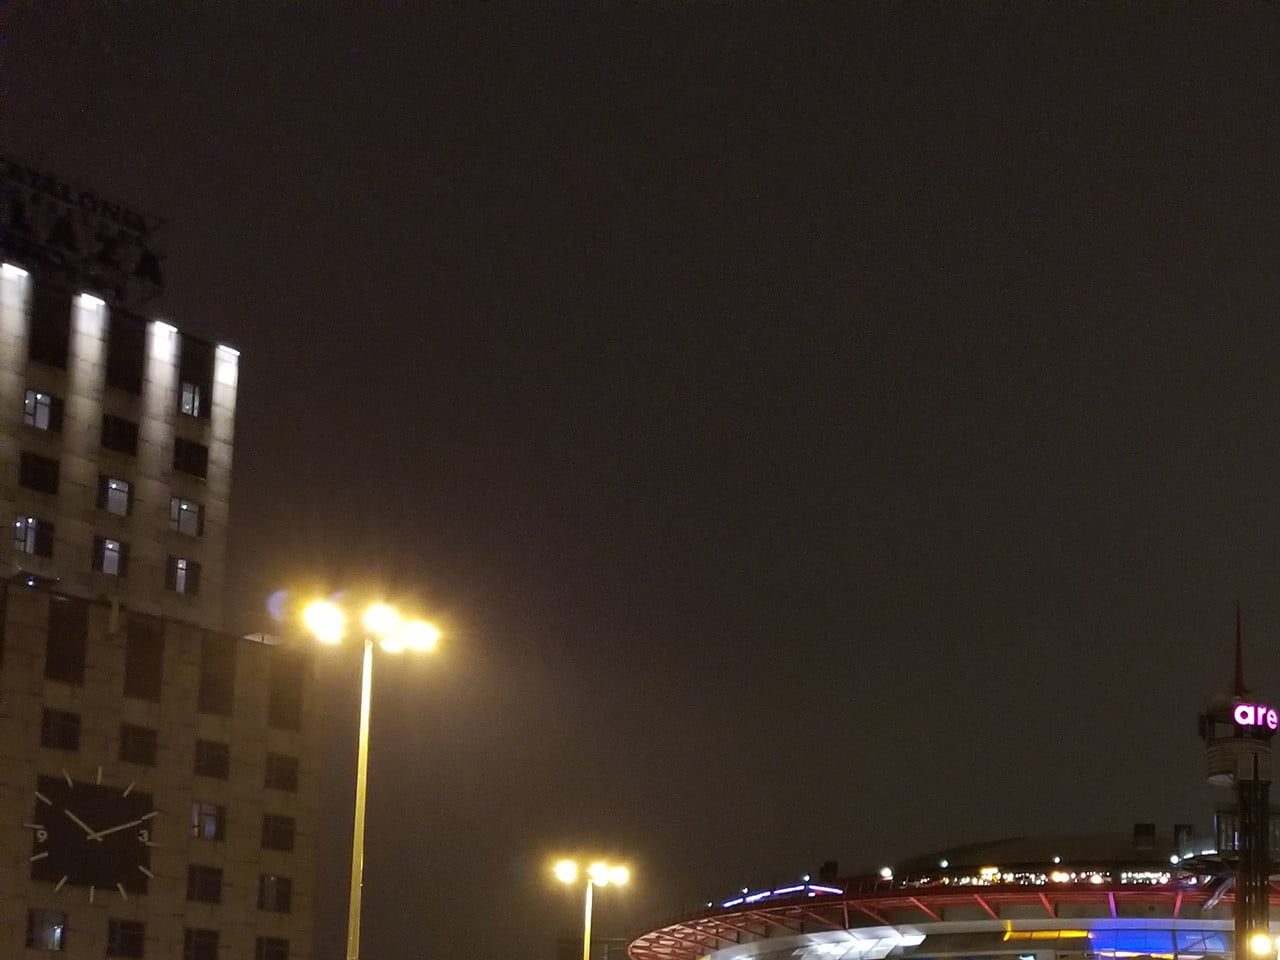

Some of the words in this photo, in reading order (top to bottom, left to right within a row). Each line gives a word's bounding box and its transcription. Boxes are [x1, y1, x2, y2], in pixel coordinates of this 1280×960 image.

[1234, 704, 1278, 730] are
[36, 829, 48, 843] 9
[138, 829, 149, 842] 3
